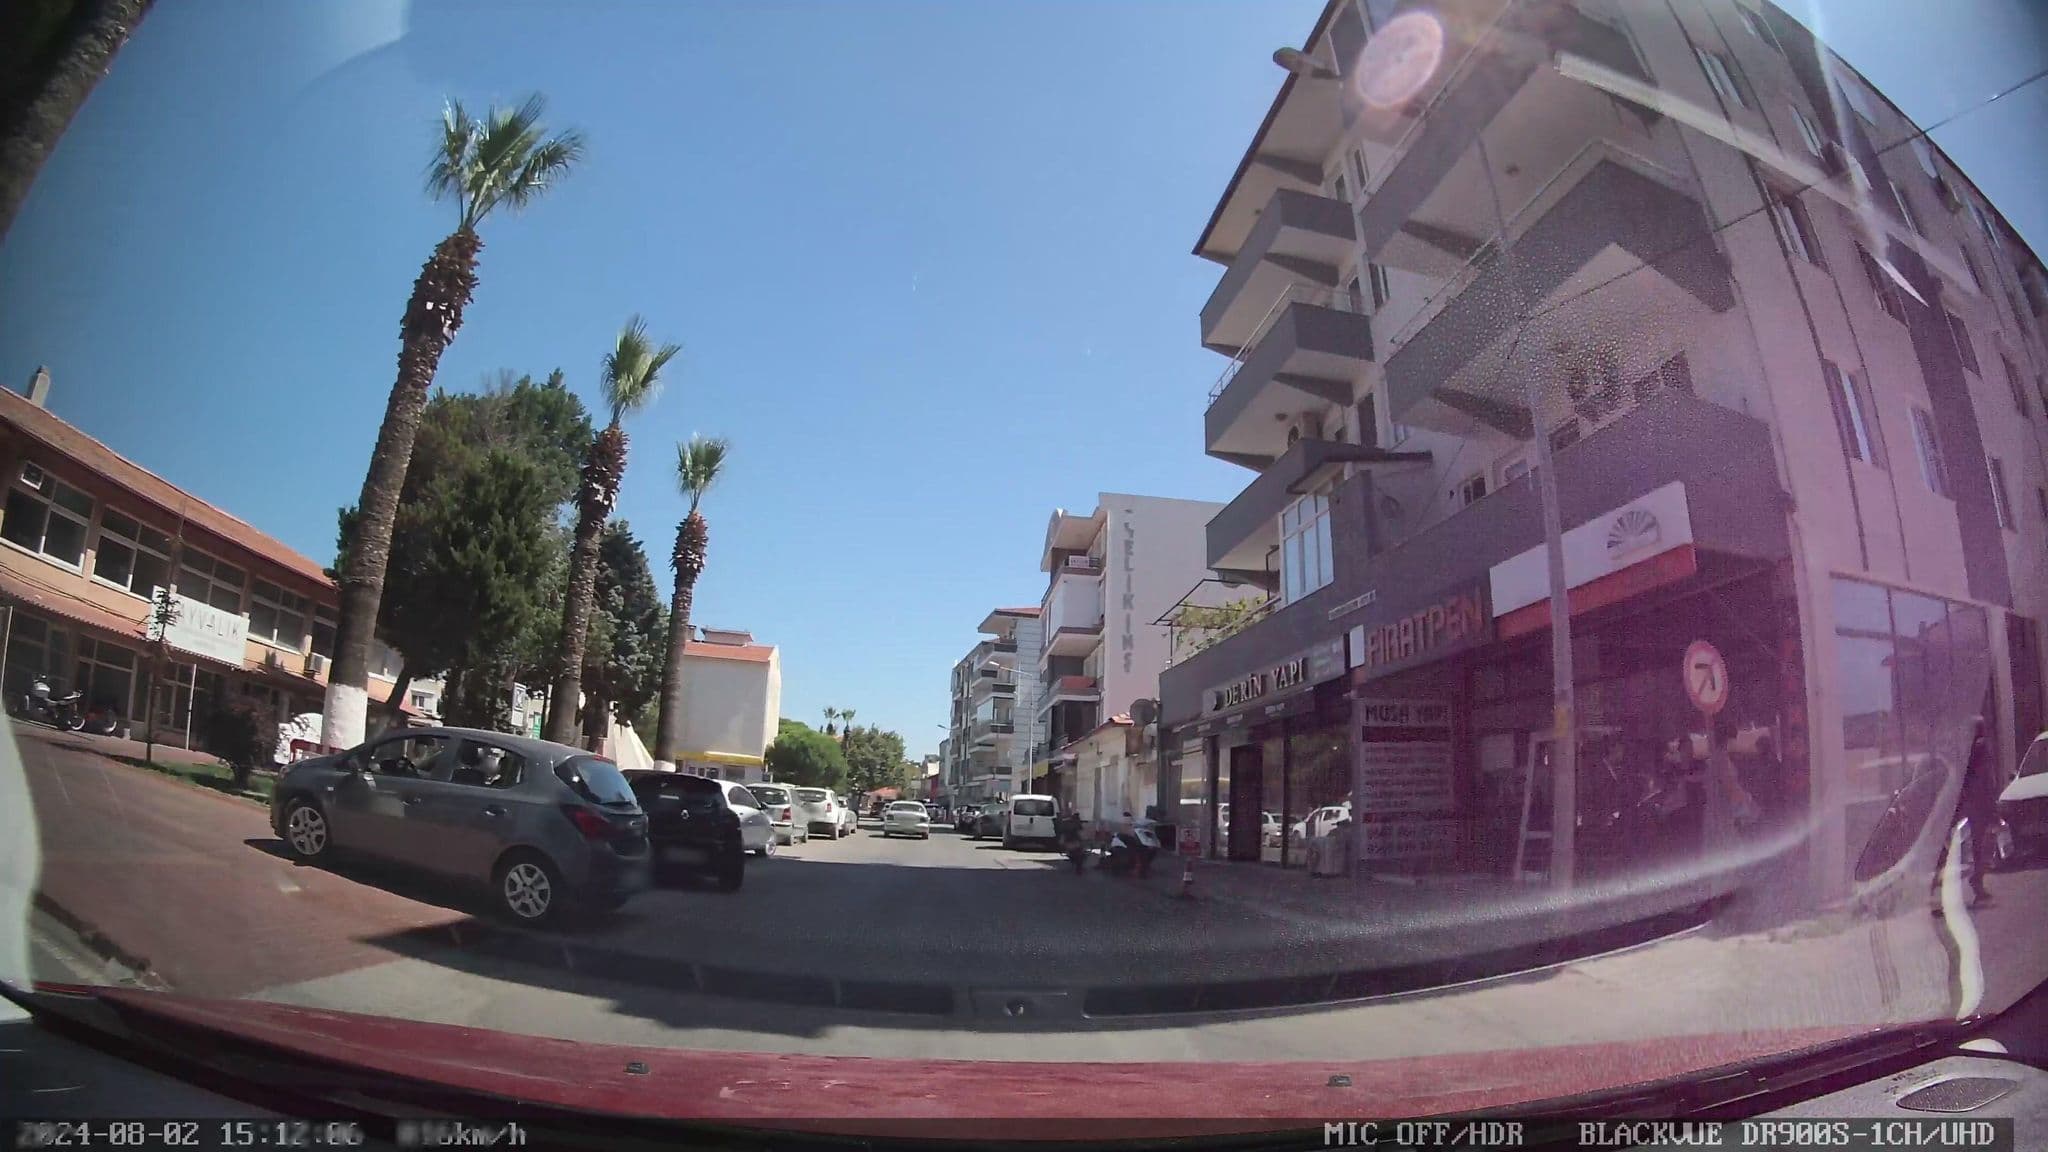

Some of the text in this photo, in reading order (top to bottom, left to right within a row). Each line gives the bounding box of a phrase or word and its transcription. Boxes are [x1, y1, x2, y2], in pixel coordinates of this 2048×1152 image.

[175, 599, 242, 640] YVALIK
[1224, 671, 1264, 708] DERİN
[1270, 655, 1305, 691] YAPI
